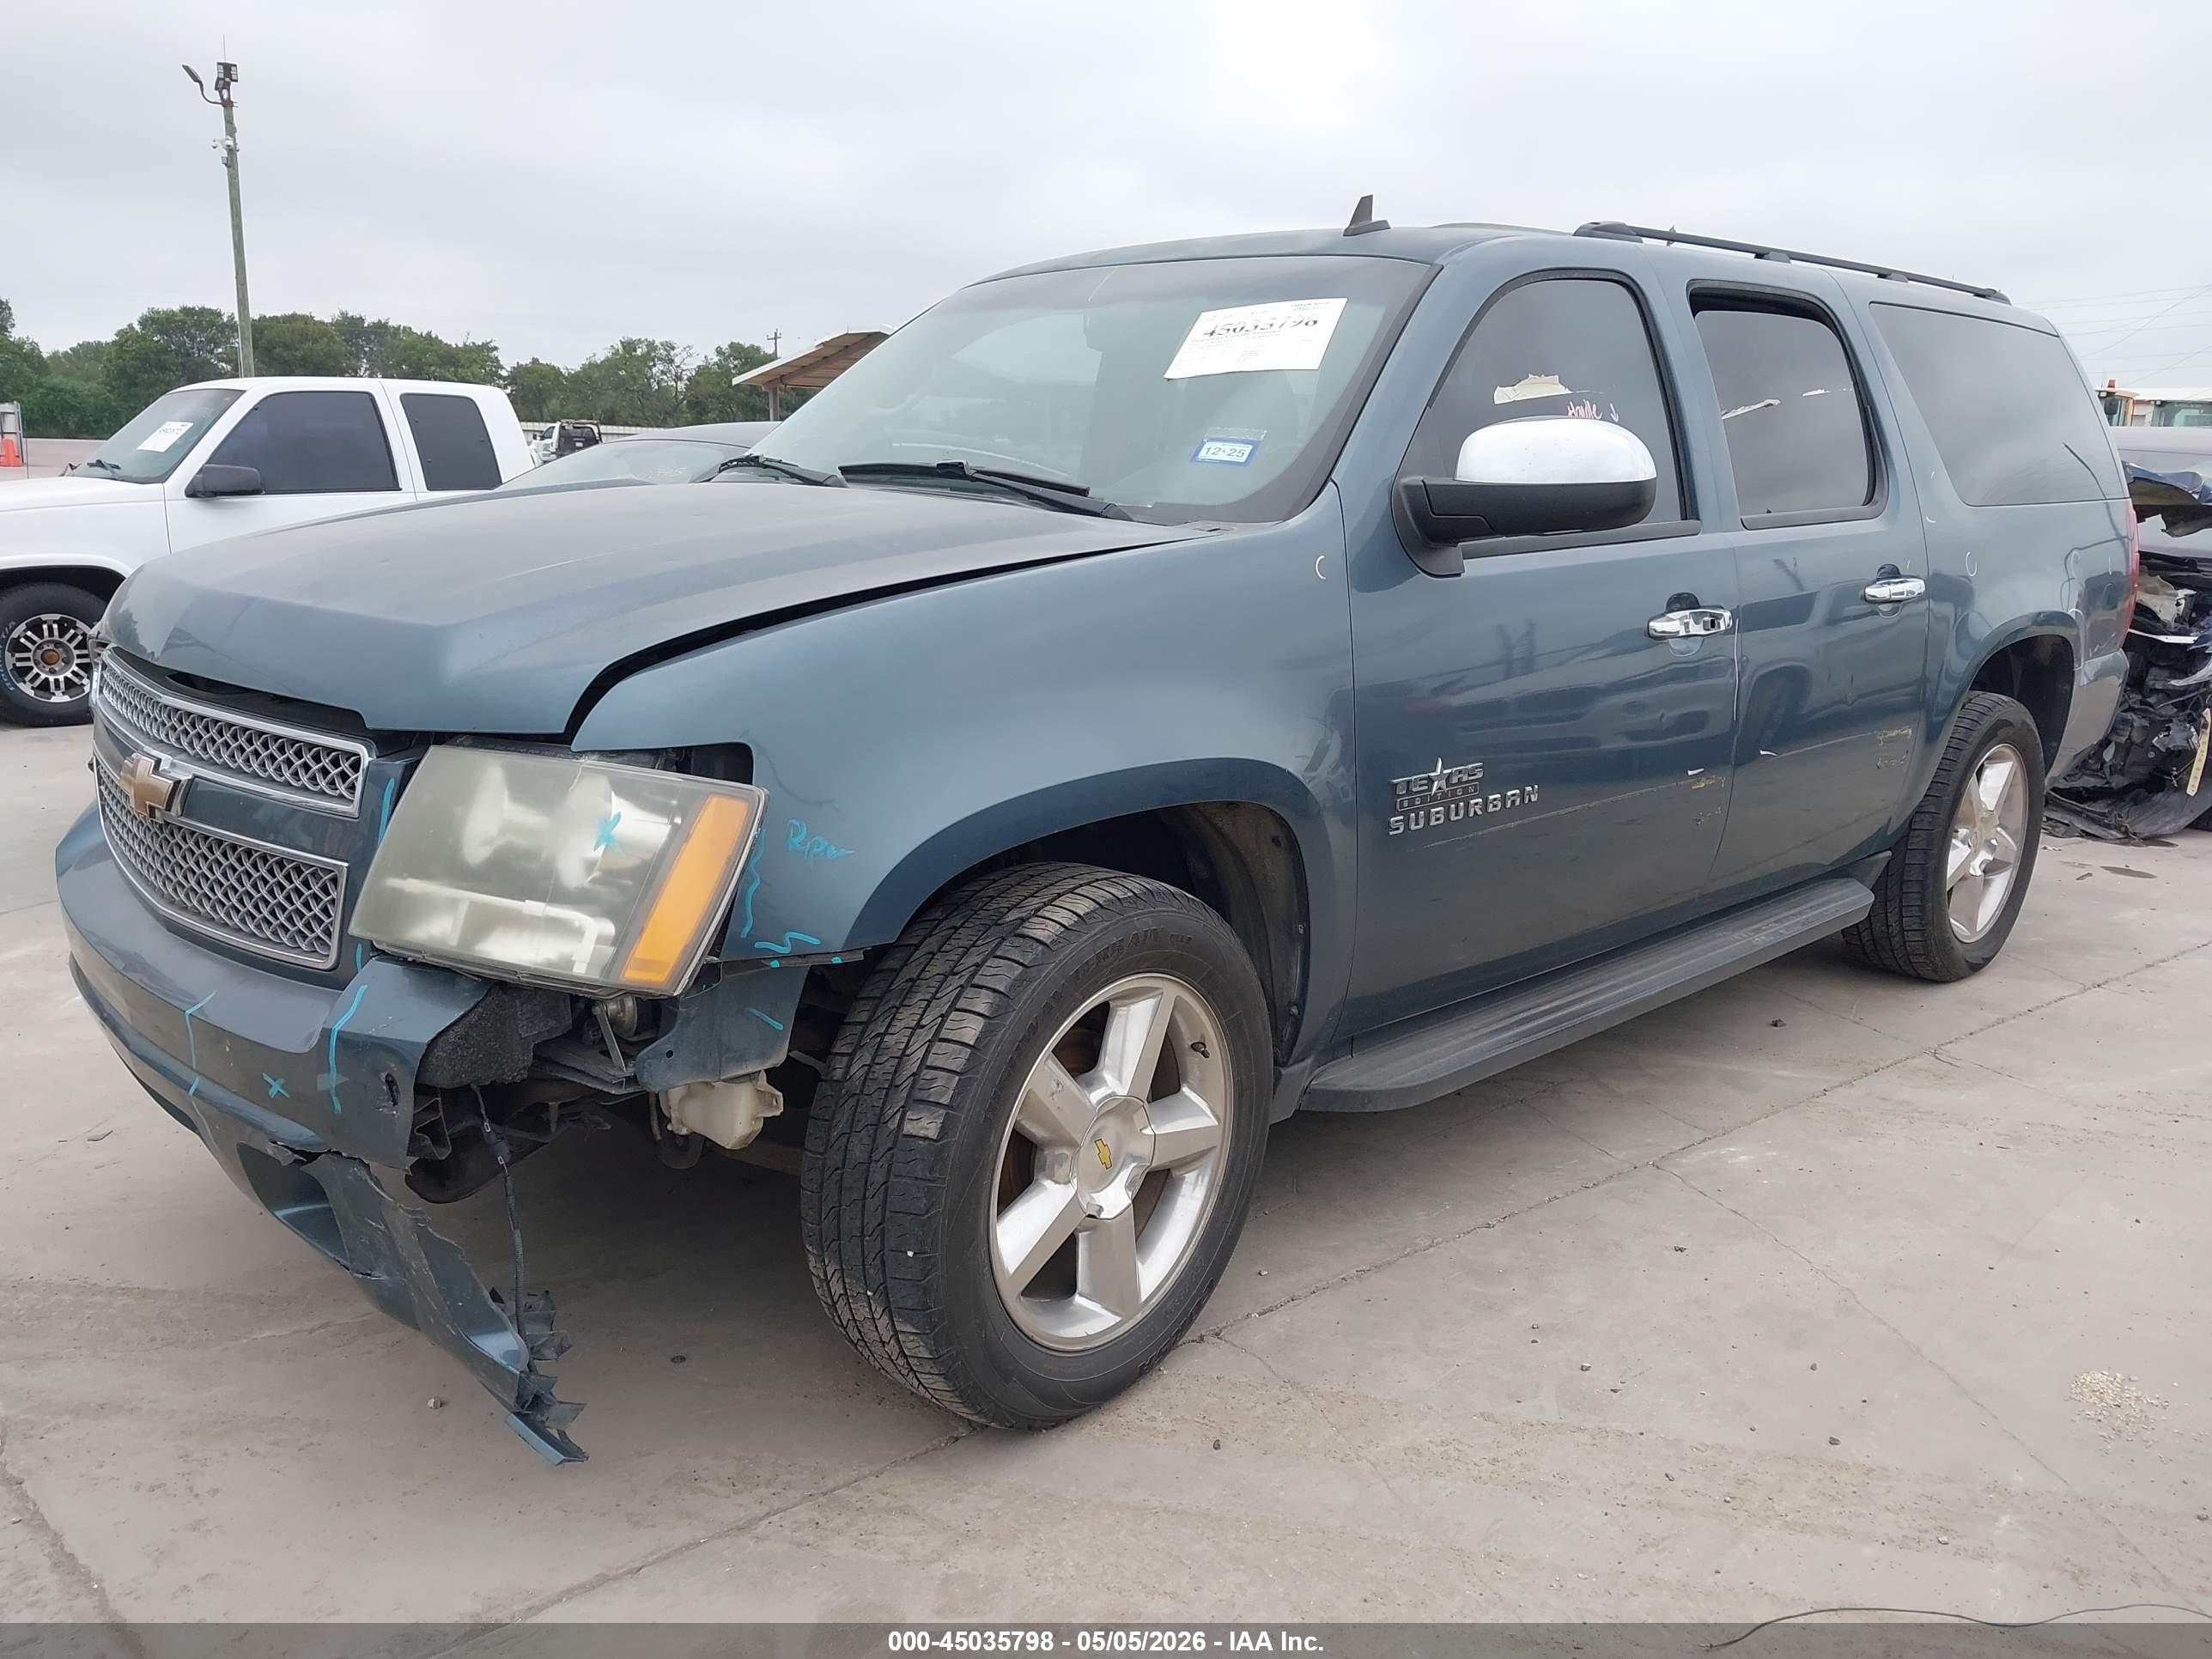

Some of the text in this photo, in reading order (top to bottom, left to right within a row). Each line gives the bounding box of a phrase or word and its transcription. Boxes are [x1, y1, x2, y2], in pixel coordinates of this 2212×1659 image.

[1204, 446, 1247, 458] 12 25
[1389, 757, 1485, 796] TEXAS
[1388, 784, 1540, 836] SUBURBAN
[1400, 786, 1476, 807] EDITION
